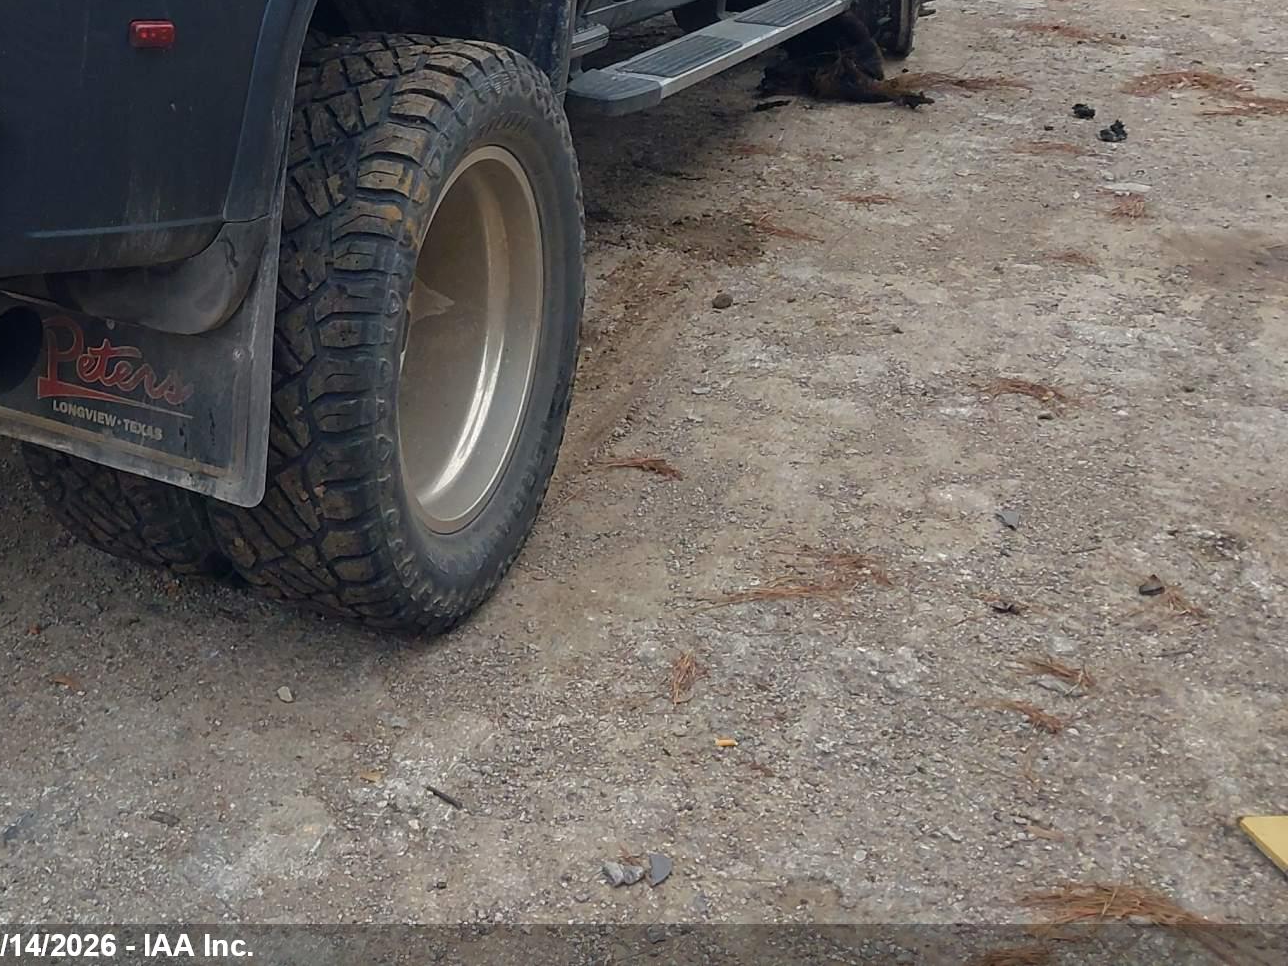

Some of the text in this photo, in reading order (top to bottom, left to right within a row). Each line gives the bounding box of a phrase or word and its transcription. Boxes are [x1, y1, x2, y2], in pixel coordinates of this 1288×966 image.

[40, 316, 194, 407] Peters
[52, 398, 163, 441] LONGVIEW TEXAS
